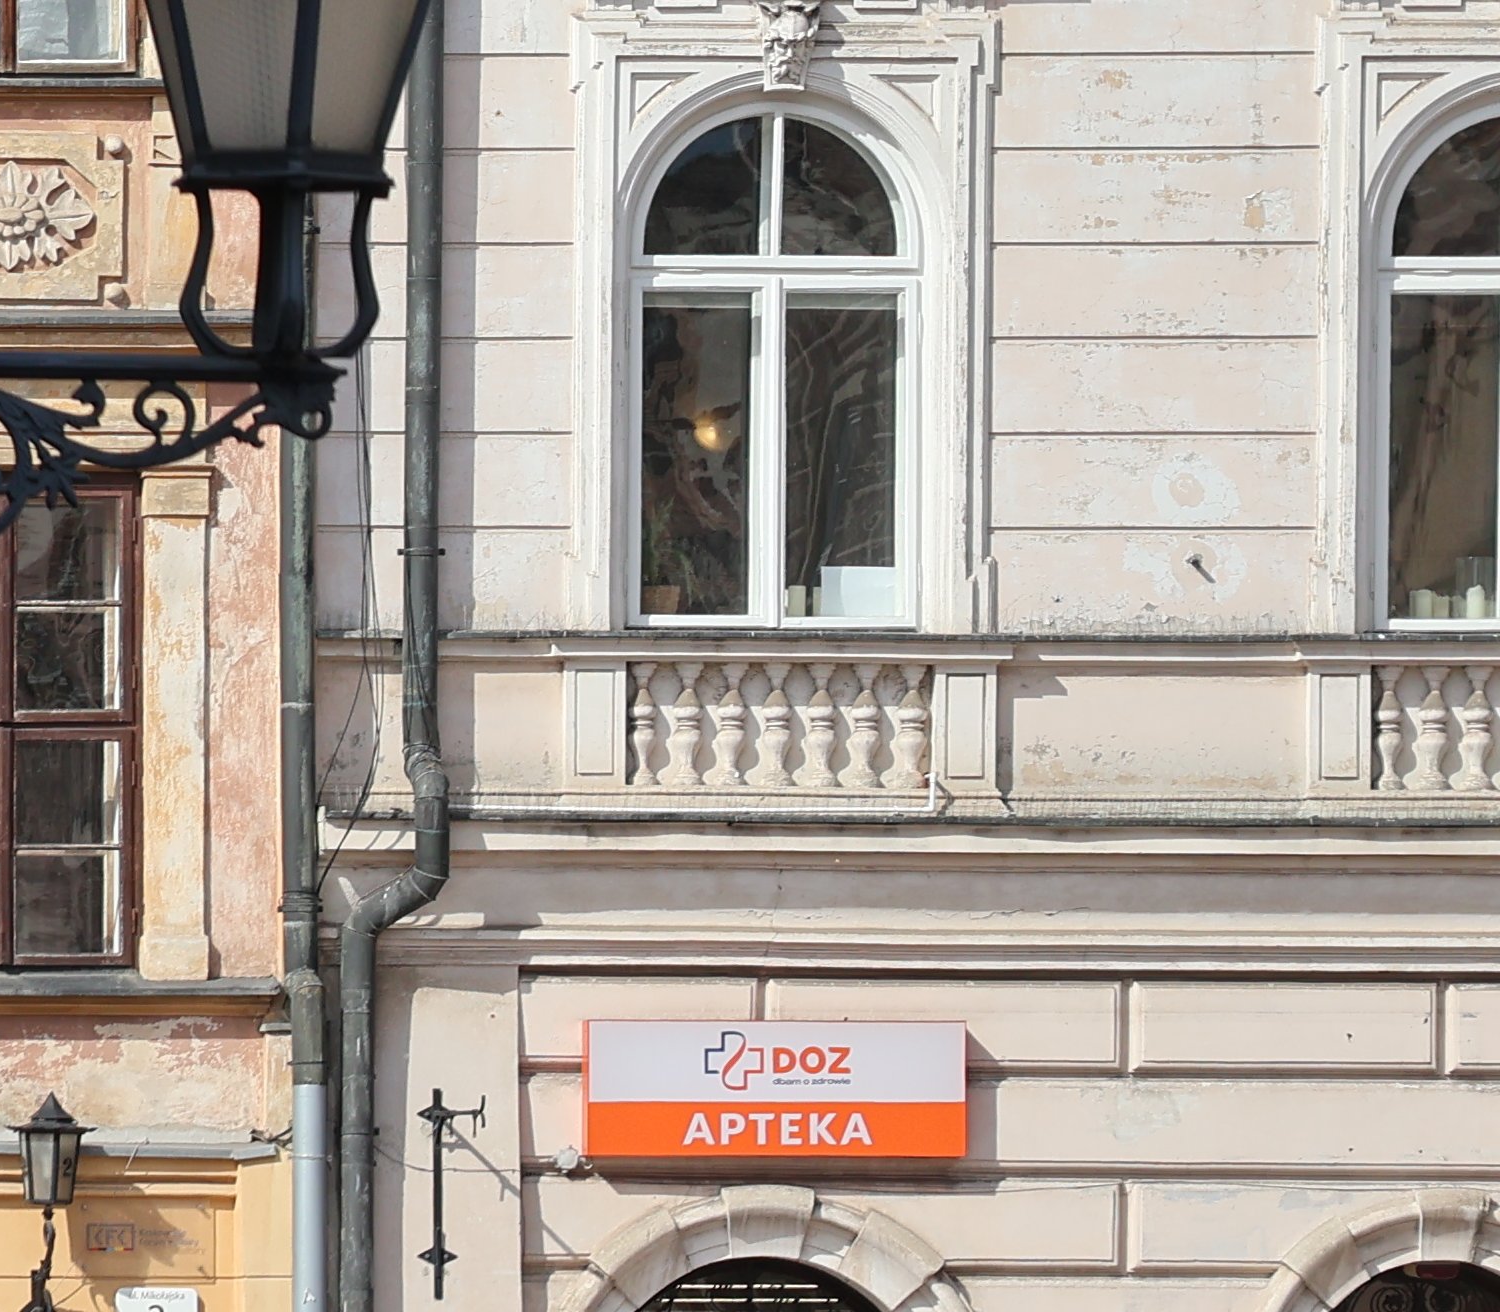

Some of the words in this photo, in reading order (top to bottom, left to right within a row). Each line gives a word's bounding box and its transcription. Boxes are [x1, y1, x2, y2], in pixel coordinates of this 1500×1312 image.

[772, 1046, 851, 1074] DOZ
[682, 1113, 873, 1145] APTEKA
[62, 1158, 72, 1177] 2
